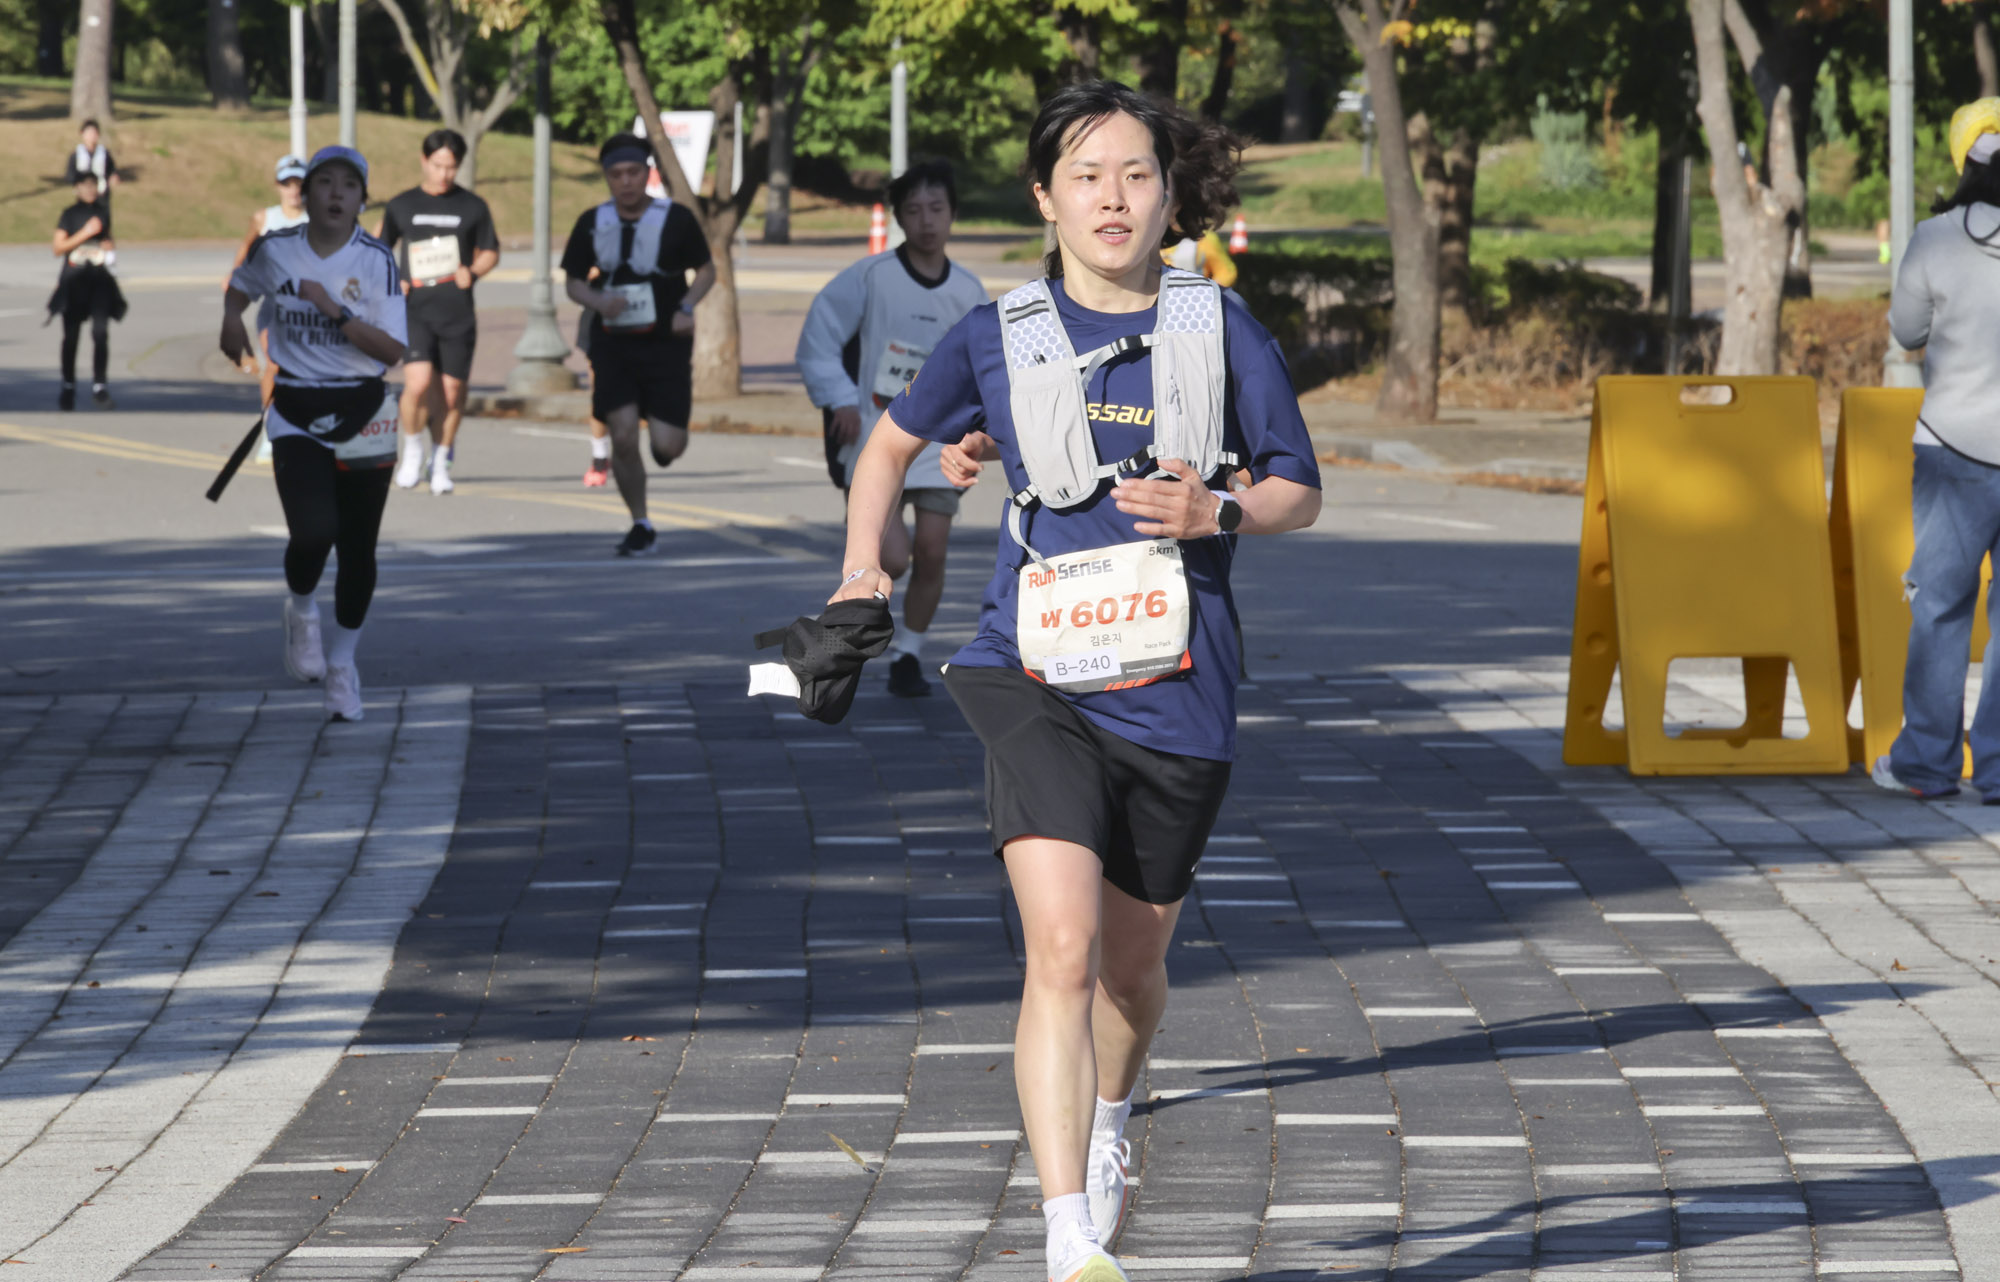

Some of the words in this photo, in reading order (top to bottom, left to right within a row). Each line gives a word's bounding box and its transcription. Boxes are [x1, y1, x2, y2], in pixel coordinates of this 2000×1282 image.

[276, 304, 335, 328] Emira
[1087, 403, 1155, 426] ssau
[1148, 545, 1174, 556] 5km
[1040, 608, 1063, 628] W
[1070, 590, 1168, 628] 6076
[1090, 633, 1122, 647] 김은지
[1056, 655, 1111, 676] B-240
